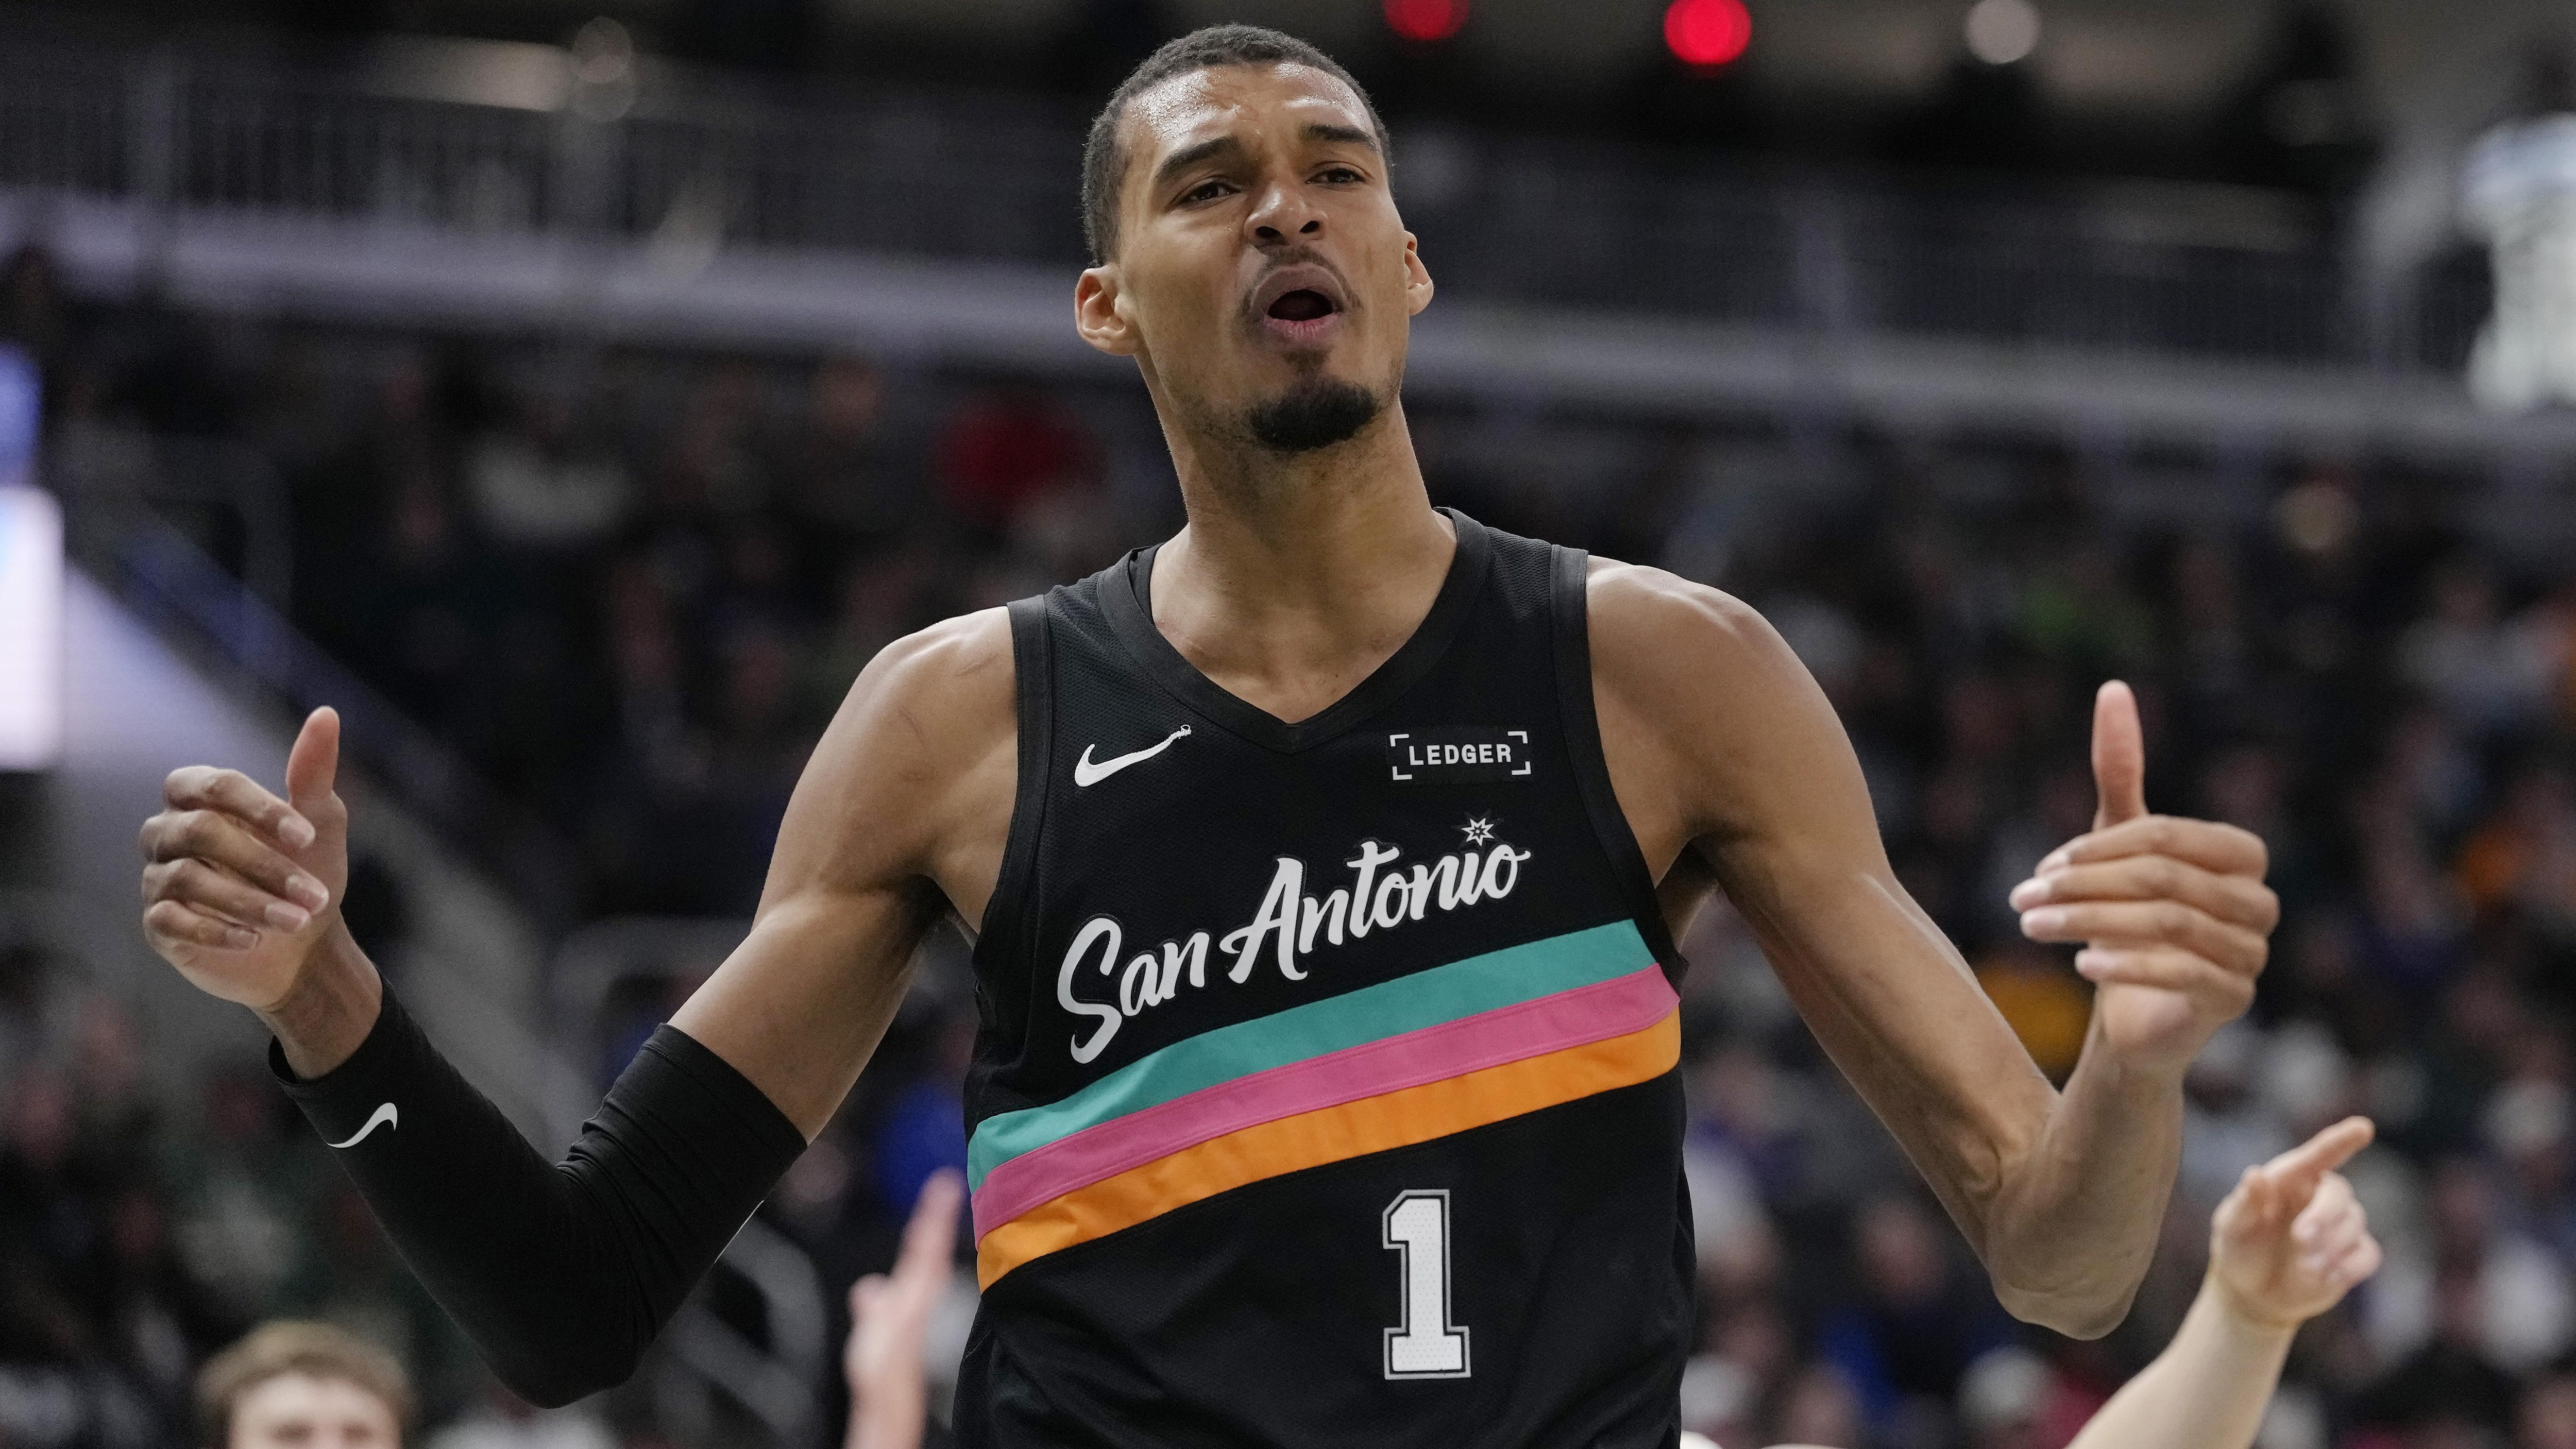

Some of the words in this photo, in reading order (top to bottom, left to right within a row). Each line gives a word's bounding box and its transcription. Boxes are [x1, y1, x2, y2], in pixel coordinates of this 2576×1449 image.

[1409, 743, 1512, 766] LEDGER
[1057, 917, 1211, 1065] San
[1218, 819, 1532, 984] Antonio
[1382, 1189, 1472, 1380] 1
